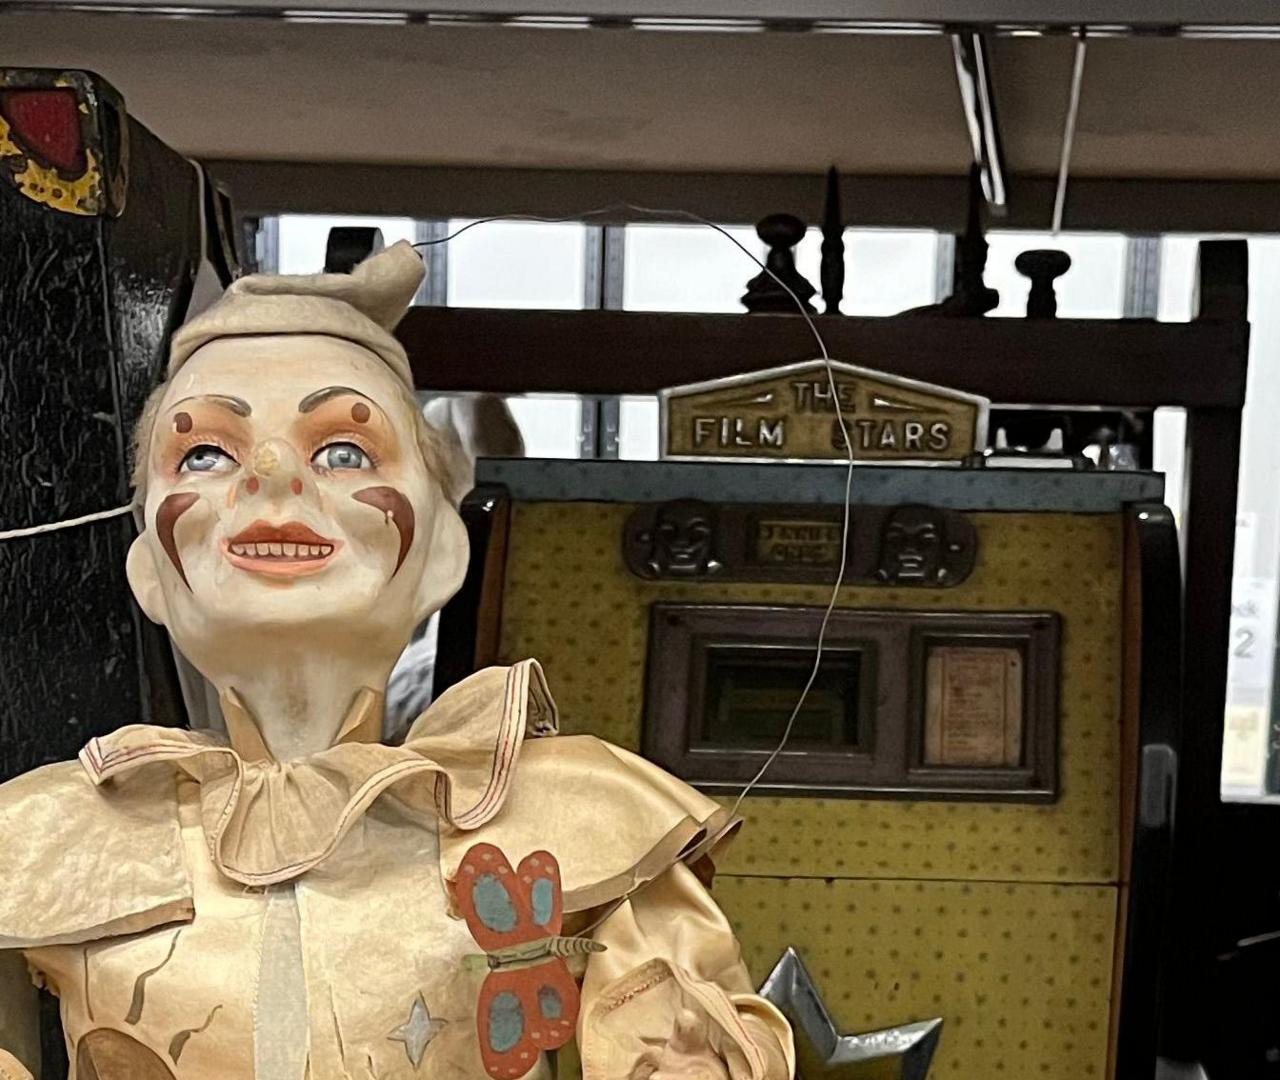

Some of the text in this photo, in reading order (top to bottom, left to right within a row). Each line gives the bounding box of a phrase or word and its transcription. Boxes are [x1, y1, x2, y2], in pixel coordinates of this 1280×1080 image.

[791, 381, 856, 413] THE
[693, 416, 951, 450] FILM STARS
